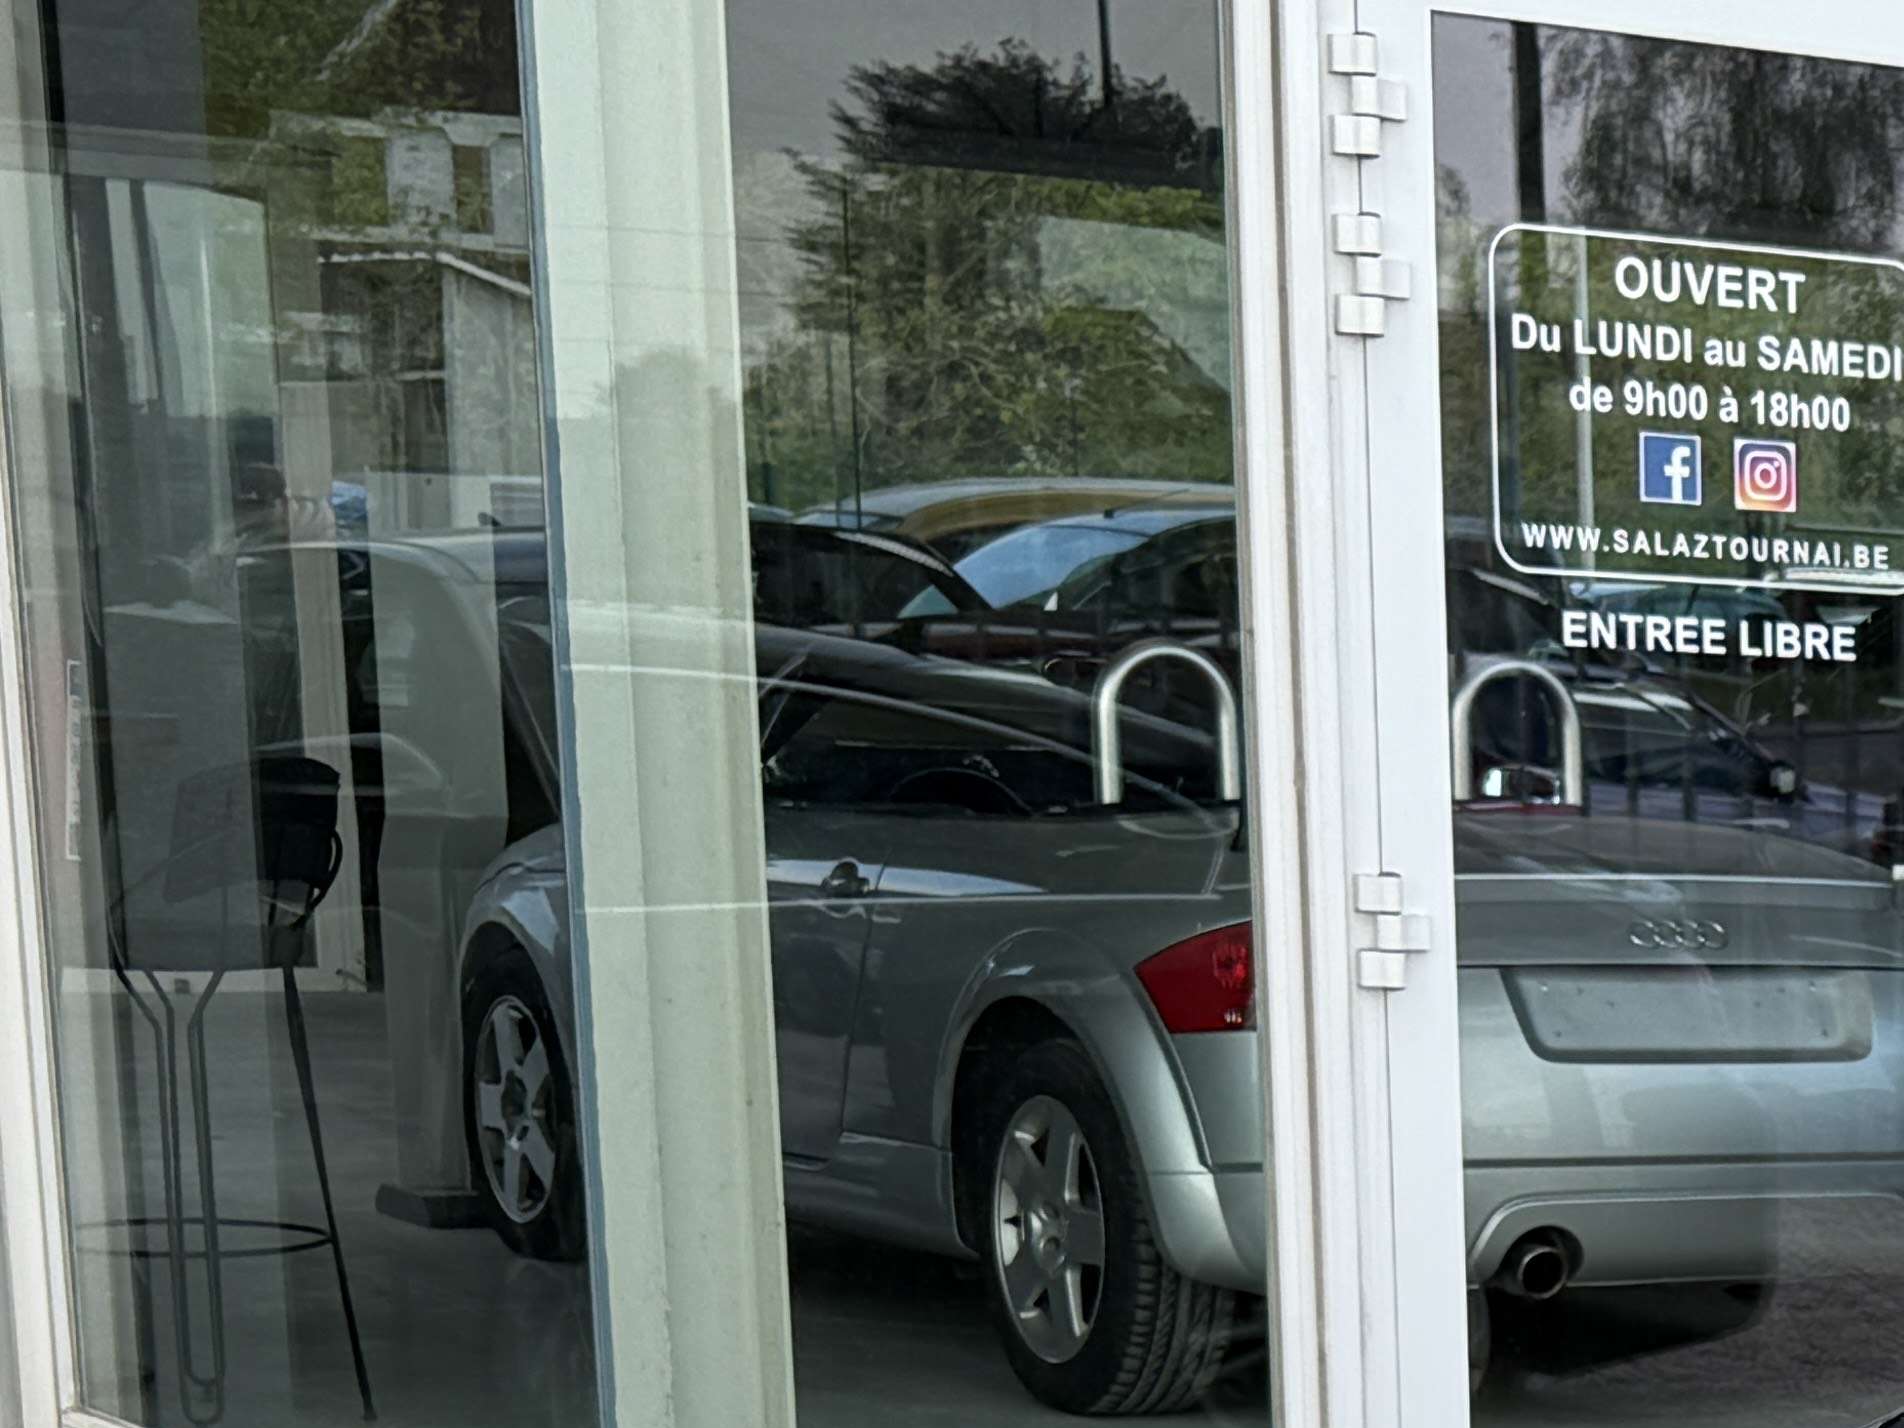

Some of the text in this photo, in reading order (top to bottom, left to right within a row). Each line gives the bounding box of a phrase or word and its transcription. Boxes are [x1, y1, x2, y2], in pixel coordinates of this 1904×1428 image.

[1614, 256, 1806, 314] OUVERT
[1511, 313, 1902, 382] Du LUNDI au SAMEDI
[1569, 376, 1851, 432] de 9h00 à 18h00
[1521, 522, 1890, 571] WWW.SALAZTOURNAI.BE
[1561, 610, 1857, 662] ENTREE LIBRE
